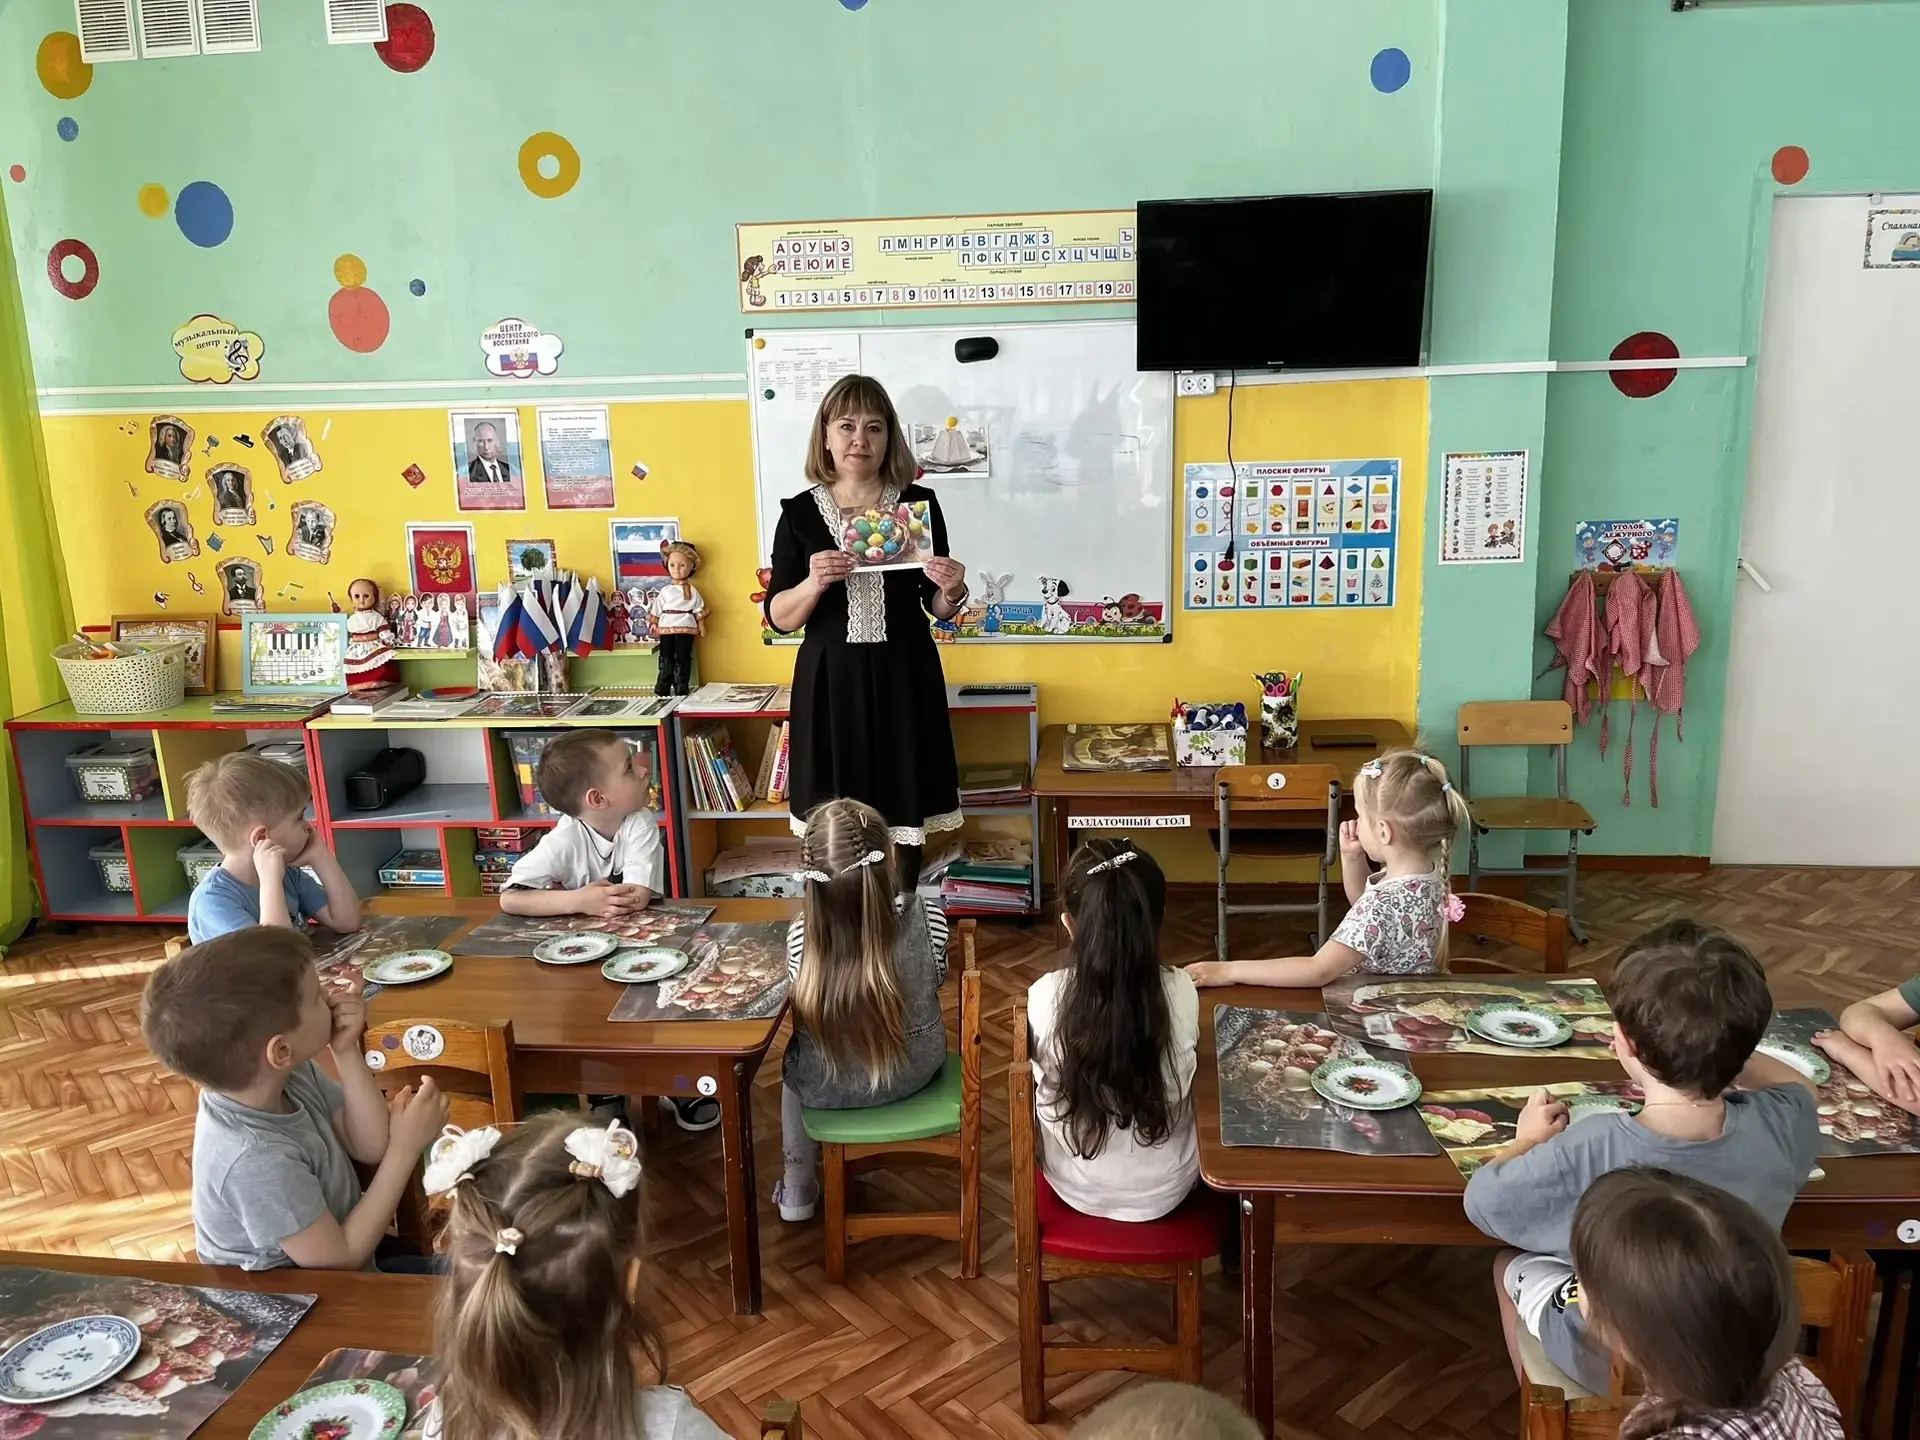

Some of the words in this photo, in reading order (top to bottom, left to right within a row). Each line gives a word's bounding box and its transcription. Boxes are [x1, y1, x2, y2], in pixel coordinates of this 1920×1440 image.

[881, 239, 891, 249] Л
[898, 239, 907, 249] М
[914, 238, 922, 248] Н
[930, 238, 938, 248] Р
[946, 234, 954, 247] Й
[962, 237, 970, 246] Б
[978, 236, 986, 246] В
[994, 236, 1001, 245] Г
[1009, 235, 1018, 247] Д
[1024, 234, 1035, 244] Ж
[1042, 234, 1049, 244] З
[1122, 232, 1132, 241] Ъ
[776, 243, 785, 254] А
[792, 243, 802, 253] О
[809, 242, 816, 252] У
[824, 241, 835, 252] Ы
[841, 241, 849, 251] Э
[962, 253, 970, 263] П
[977, 253, 987, 263] Ф
[994, 252, 1002, 262] К
[1010, 252, 1018, 262] Т
[1024, 251, 1035, 261] Ш
[1042, 251, 1050, 261] С
[1058, 250, 1066, 260] Х
[1074, 250, 1083, 262] Ц
[1091, 249, 1098, 259] Ч
[1105, 248, 1117, 261] Щ
[1123, 248, 1131, 258] Ь
[777, 260, 785, 271] Я
[794, 257, 801, 270] Ё
[808, 259, 820, 270] Ю
[826, 259, 834, 269] И
[842, 258, 850, 268] Е
[780, 294, 785, 304] 1
[796, 293, 802, 304] 2
[811, 293, 818, 303] 3
[827, 292, 834, 302] 4
[844, 292, 850, 302] 5
[860, 291, 867, 302] 6
[876, 291, 883, 301] 7
[893, 290, 899, 301] 8
[908, 290, 915, 300] 9
[924, 289, 937, 300] 10
[943, 289, 955, 299] 11
[962, 288, 975, 299] 12
[981, 288, 995, 298] 13
[1001, 286, 1014, 297] 14
[1020, 286, 1034, 297] 15
[1039, 285, 1053, 296] 16
[1059, 285, 1072, 295] 17
[1079, 284, 1092, 295] 18
[1098, 284, 1112, 294] 19
[1118, 283, 1131, 294] 20
[500, 324, 522, 332] ЦЕНТР
[196, 340, 220, 350] центр
[1272, 778, 1279, 787] 3
[1071, 817, 1151, 827] РАЗДАТОЧНЫЙ
[1155, 816, 1186, 826] СТОЛ
[703, 1083, 711, 1092] 2
[1906, 1228, 1915, 1239] 2
